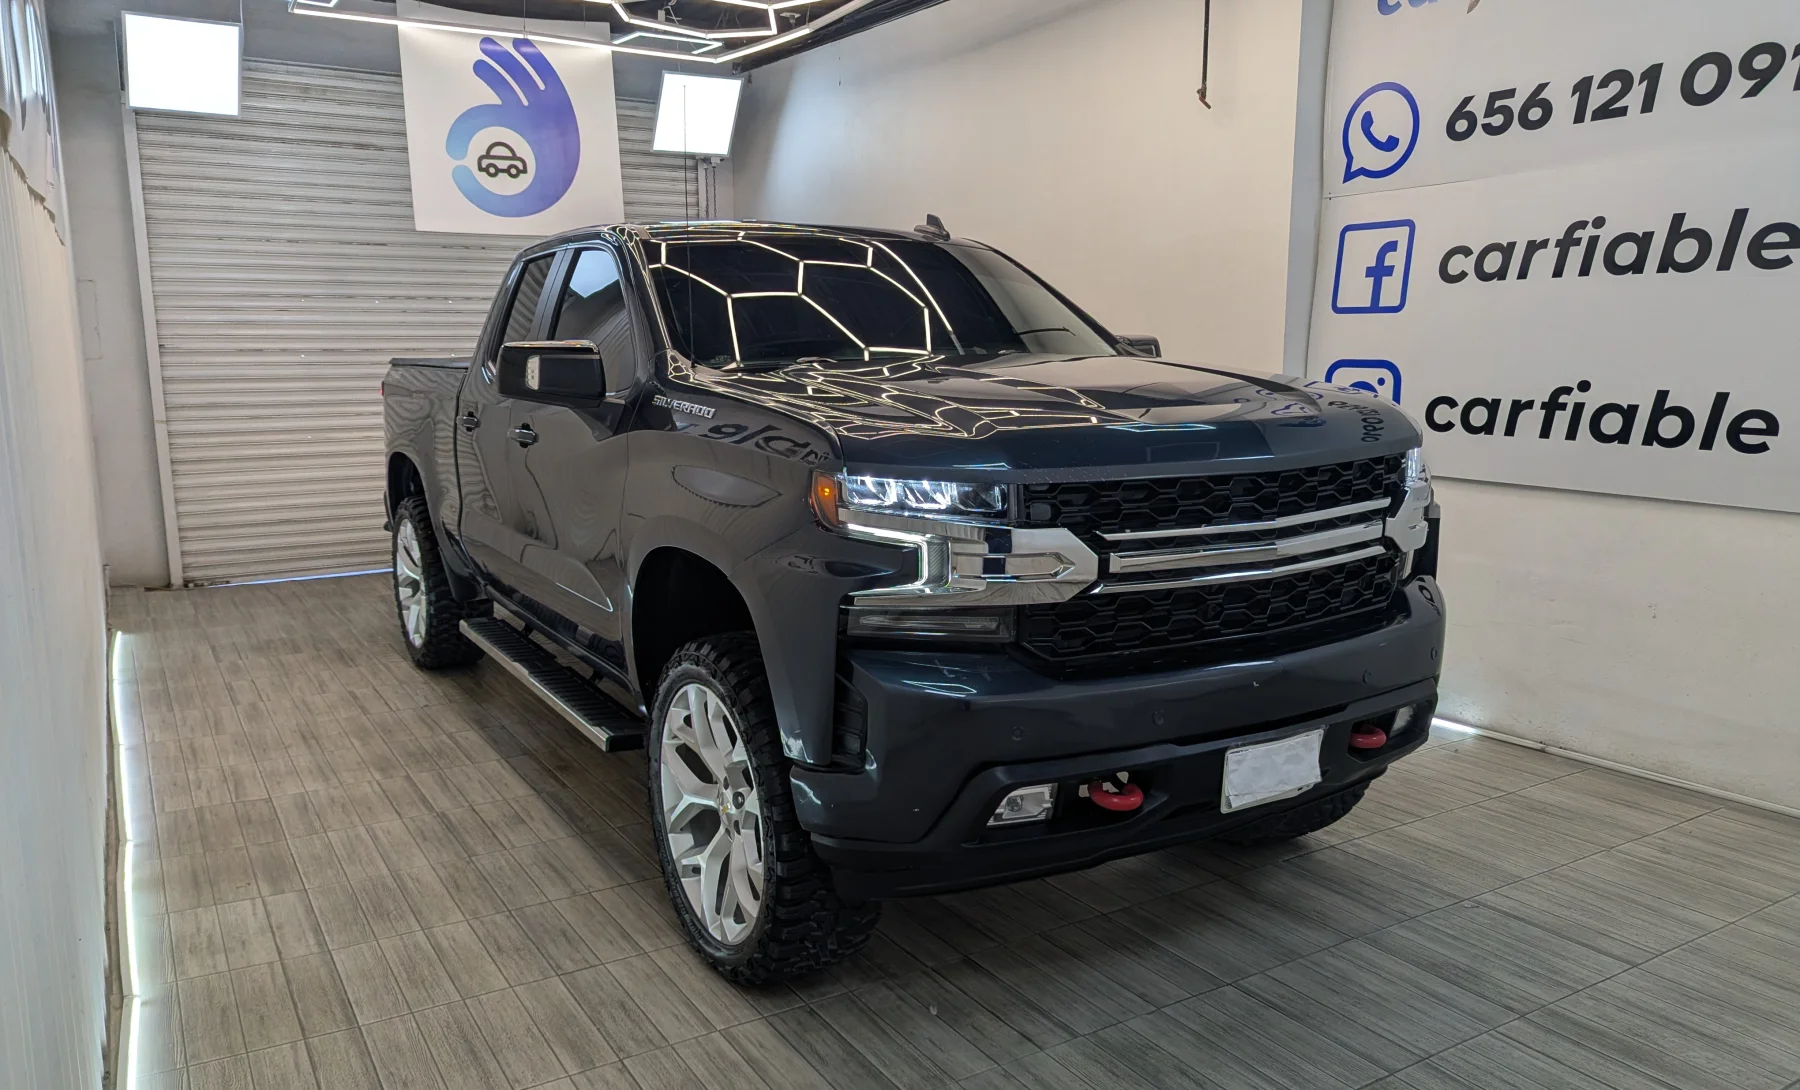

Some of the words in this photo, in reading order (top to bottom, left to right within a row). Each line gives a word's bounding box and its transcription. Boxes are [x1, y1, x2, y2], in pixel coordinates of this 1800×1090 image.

[1446, 82, 1553, 141] 656
[1571, 63, 1663, 125] 121
[1439, 208, 1800, 284] carfiable
[652, 394, 716, 419] SILVERADO
[1424, 379, 1780, 454] carfiable
